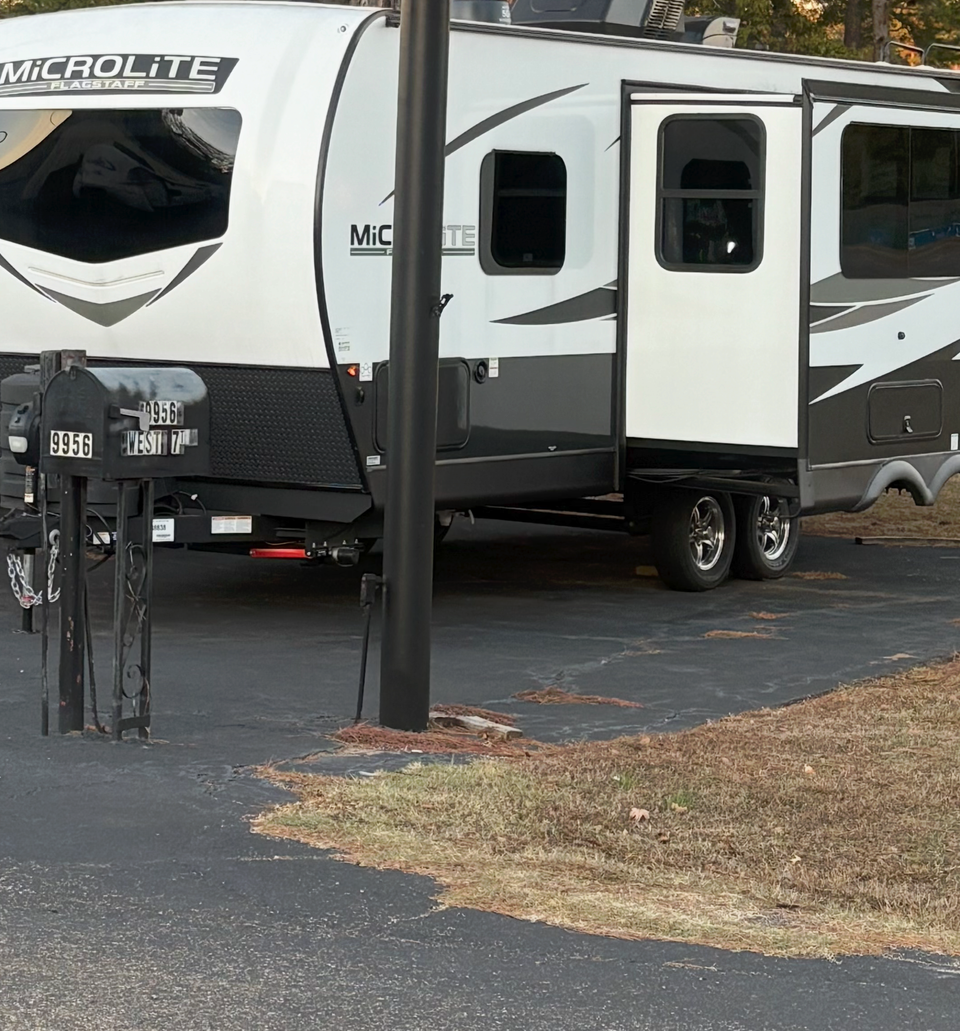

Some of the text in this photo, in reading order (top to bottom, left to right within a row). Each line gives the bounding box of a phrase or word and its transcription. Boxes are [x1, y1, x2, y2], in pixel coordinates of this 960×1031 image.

[50, 79, 145, 90] FLAGSTAFF
[145, 401, 176, 424] 9956
[51, 432, 91, 457] 9956
[128, 430, 161, 455] WEST
